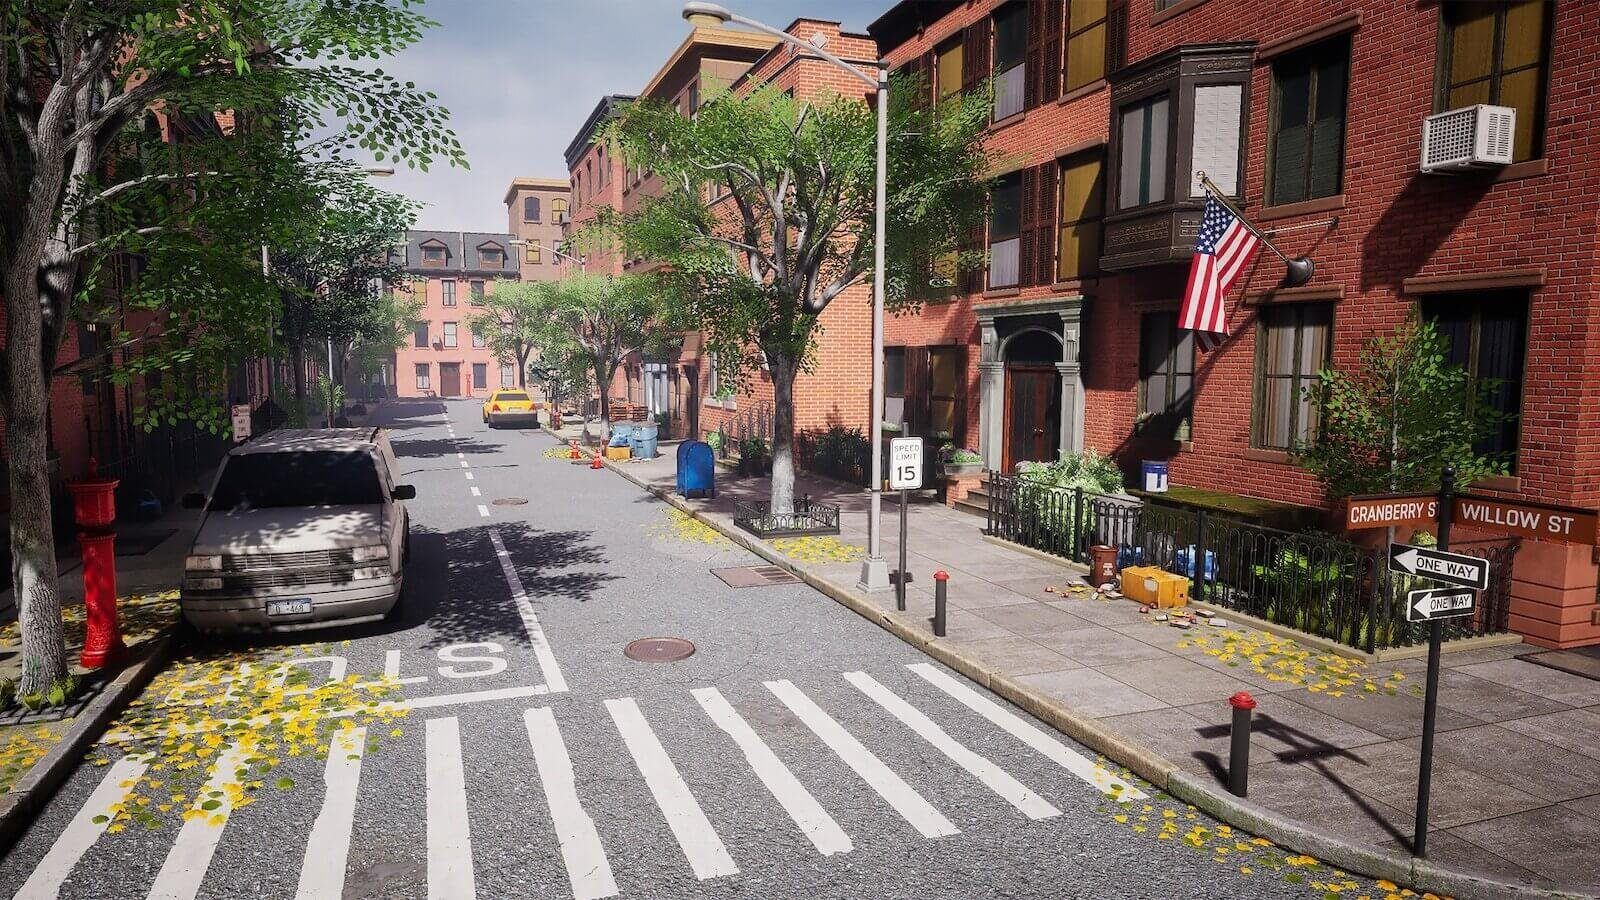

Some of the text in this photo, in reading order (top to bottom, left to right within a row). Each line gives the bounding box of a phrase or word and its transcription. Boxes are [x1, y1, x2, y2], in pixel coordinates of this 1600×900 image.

[894, 444, 919, 452] SPEED
[897, 465, 916, 481] 15
[1350, 501, 1439, 523] CRANBERRY S
[1461, 503, 1575, 535] WILLOW ST
[1416, 557, 1475, 578] ONE WAY
[1430, 593, 1471, 610] ONE WAY
